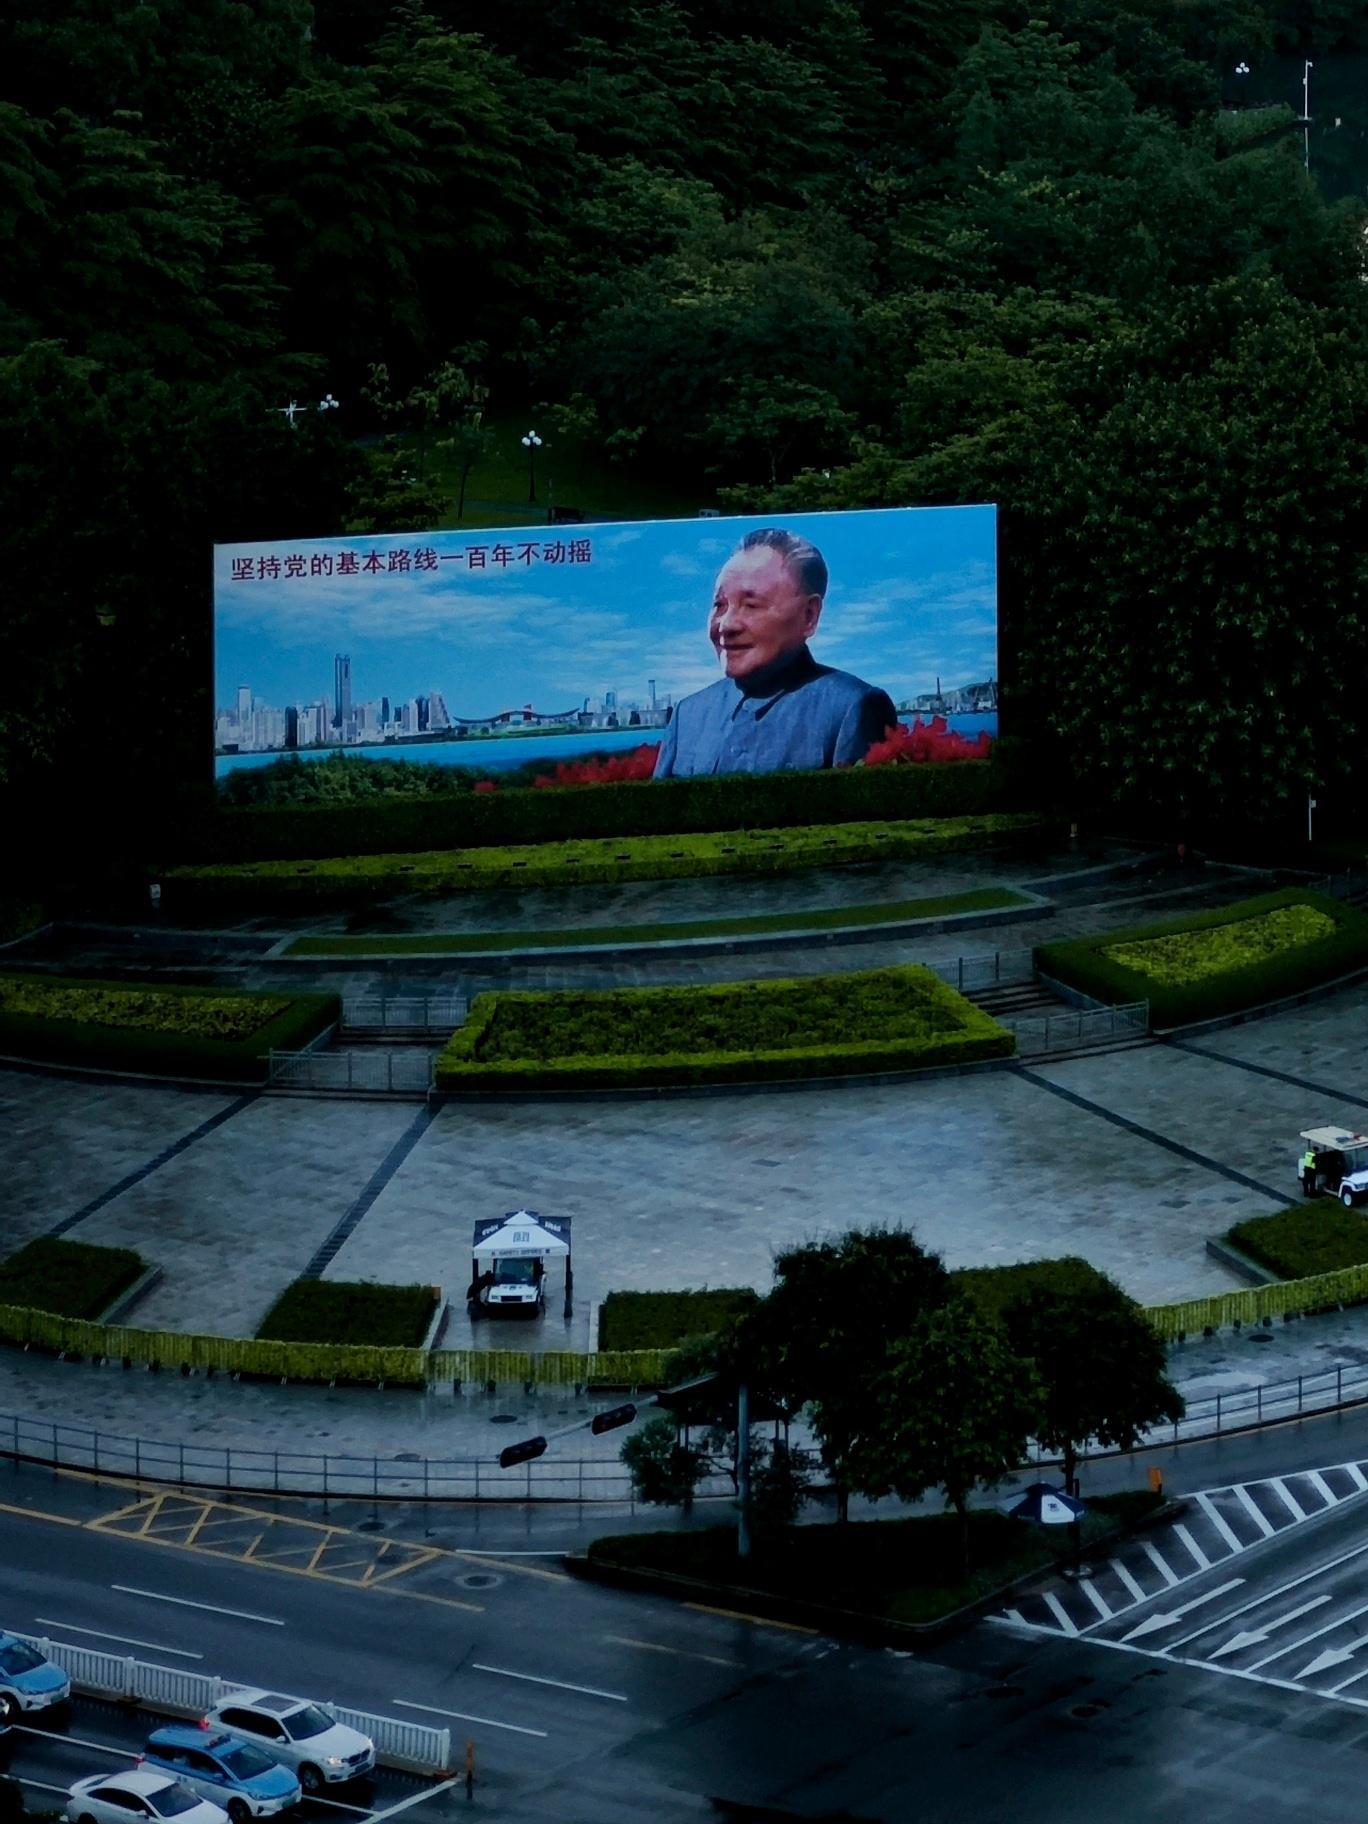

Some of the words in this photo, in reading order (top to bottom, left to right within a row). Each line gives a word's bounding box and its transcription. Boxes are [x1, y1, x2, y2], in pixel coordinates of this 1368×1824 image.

[230, 538, 592, 581] 坚持党的基本路线一百年不动摇
